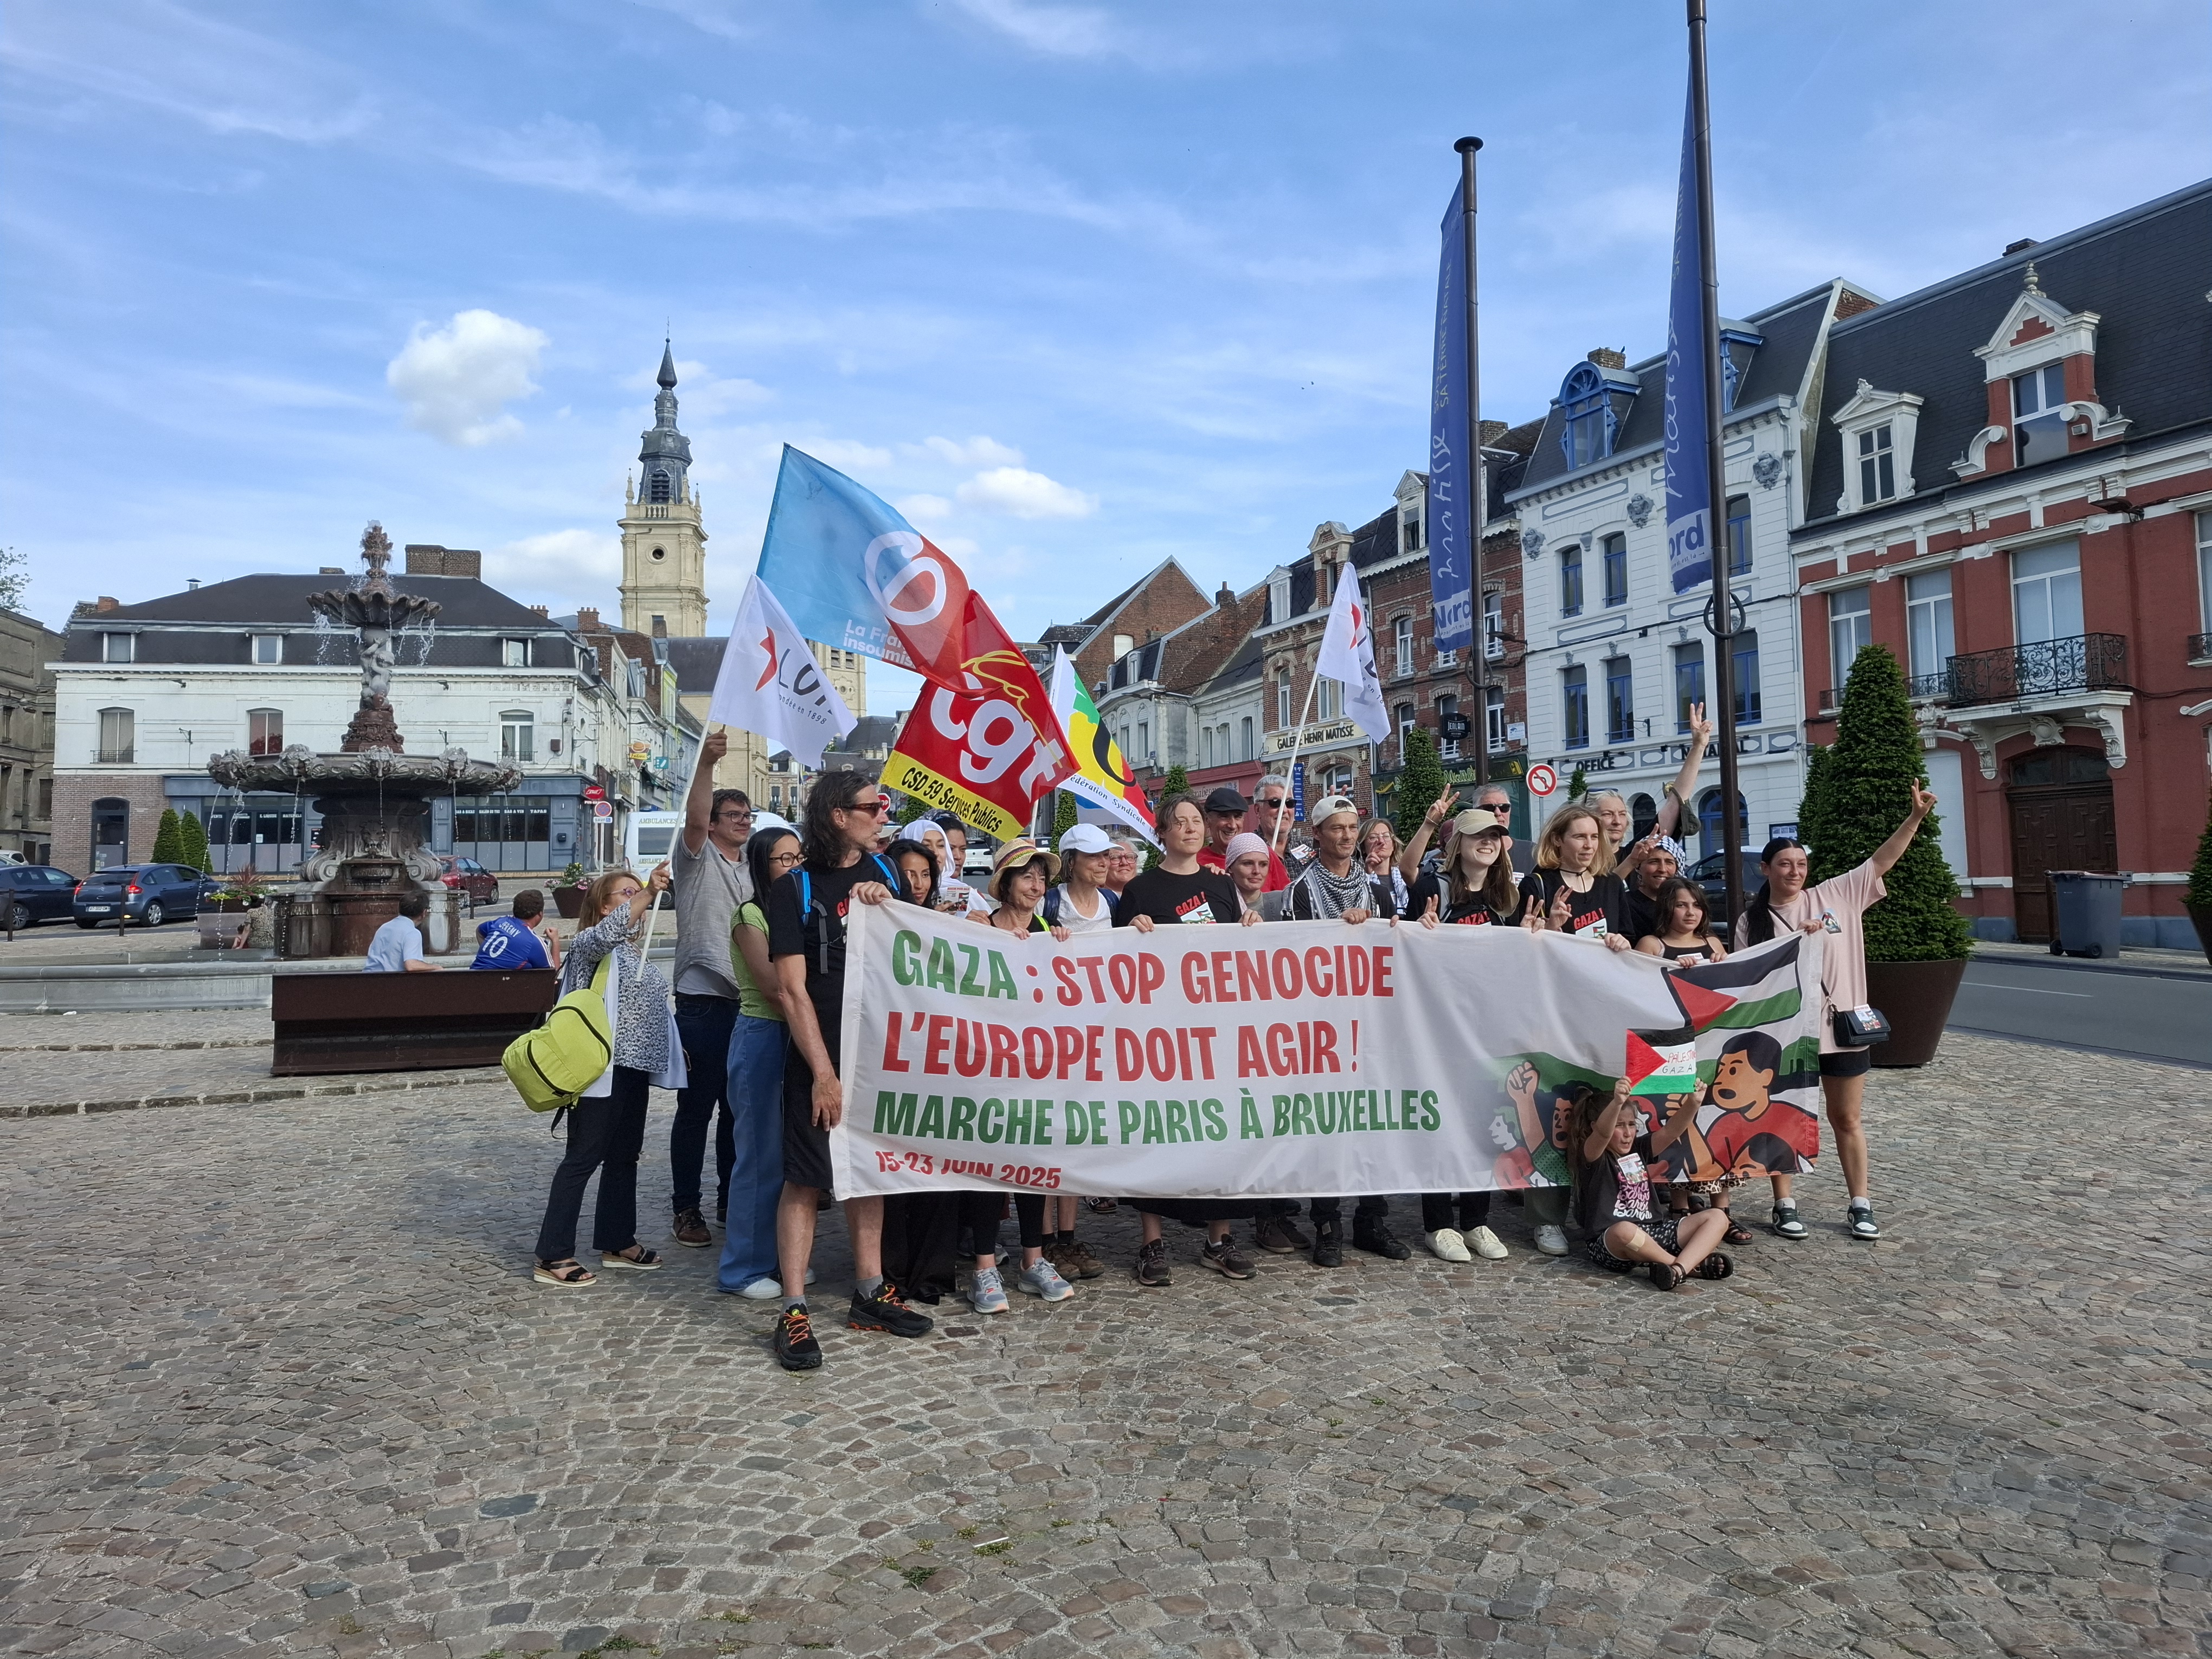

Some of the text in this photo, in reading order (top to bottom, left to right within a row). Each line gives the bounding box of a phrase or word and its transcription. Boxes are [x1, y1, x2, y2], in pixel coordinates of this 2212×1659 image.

[1440, 384, 1449, 408] SA
[1669, 513, 1705, 561] ord
[846, 619, 866, 637] La
[843, 633, 916, 667] insoumis
[779, 693, 827, 725] ondée en 1898
[1303, 730, 1324, 744] HENRI
[1325, 724, 1355, 741] MATISSE
[1447, 721, 1465, 731] JENLAIN
[1576, 756, 1616, 771] OFFICE
[901, 767, 1003, 833] CSD 59 Services Publics
[1111, 798, 1146, 827] Syndicale
[1175, 895, 1201, 916] GAZA
[499, 921, 521, 937] JEREMY
[1573, 910, 1599, 930] GAZA
[482, 930, 508, 958] 10
[892, 930, 1018, 1000] GAZA
[1052, 952, 1165, 1006] STOP
[1180, 946, 1395, 1004] GENOCIDE
[882, 1011, 1103, 1082] L'EUROPE
[1115, 1027, 1217, 1082] DOIT
[1238, 1020, 1341, 1078] AGIR
[1662, 1064, 1693, 1074] GAZA
[872, 1087, 1441, 1146] MARCHE DE PARIS À BRUXELLES
[874, 1150, 1062, 1189] 15-23 JUIN 2025
